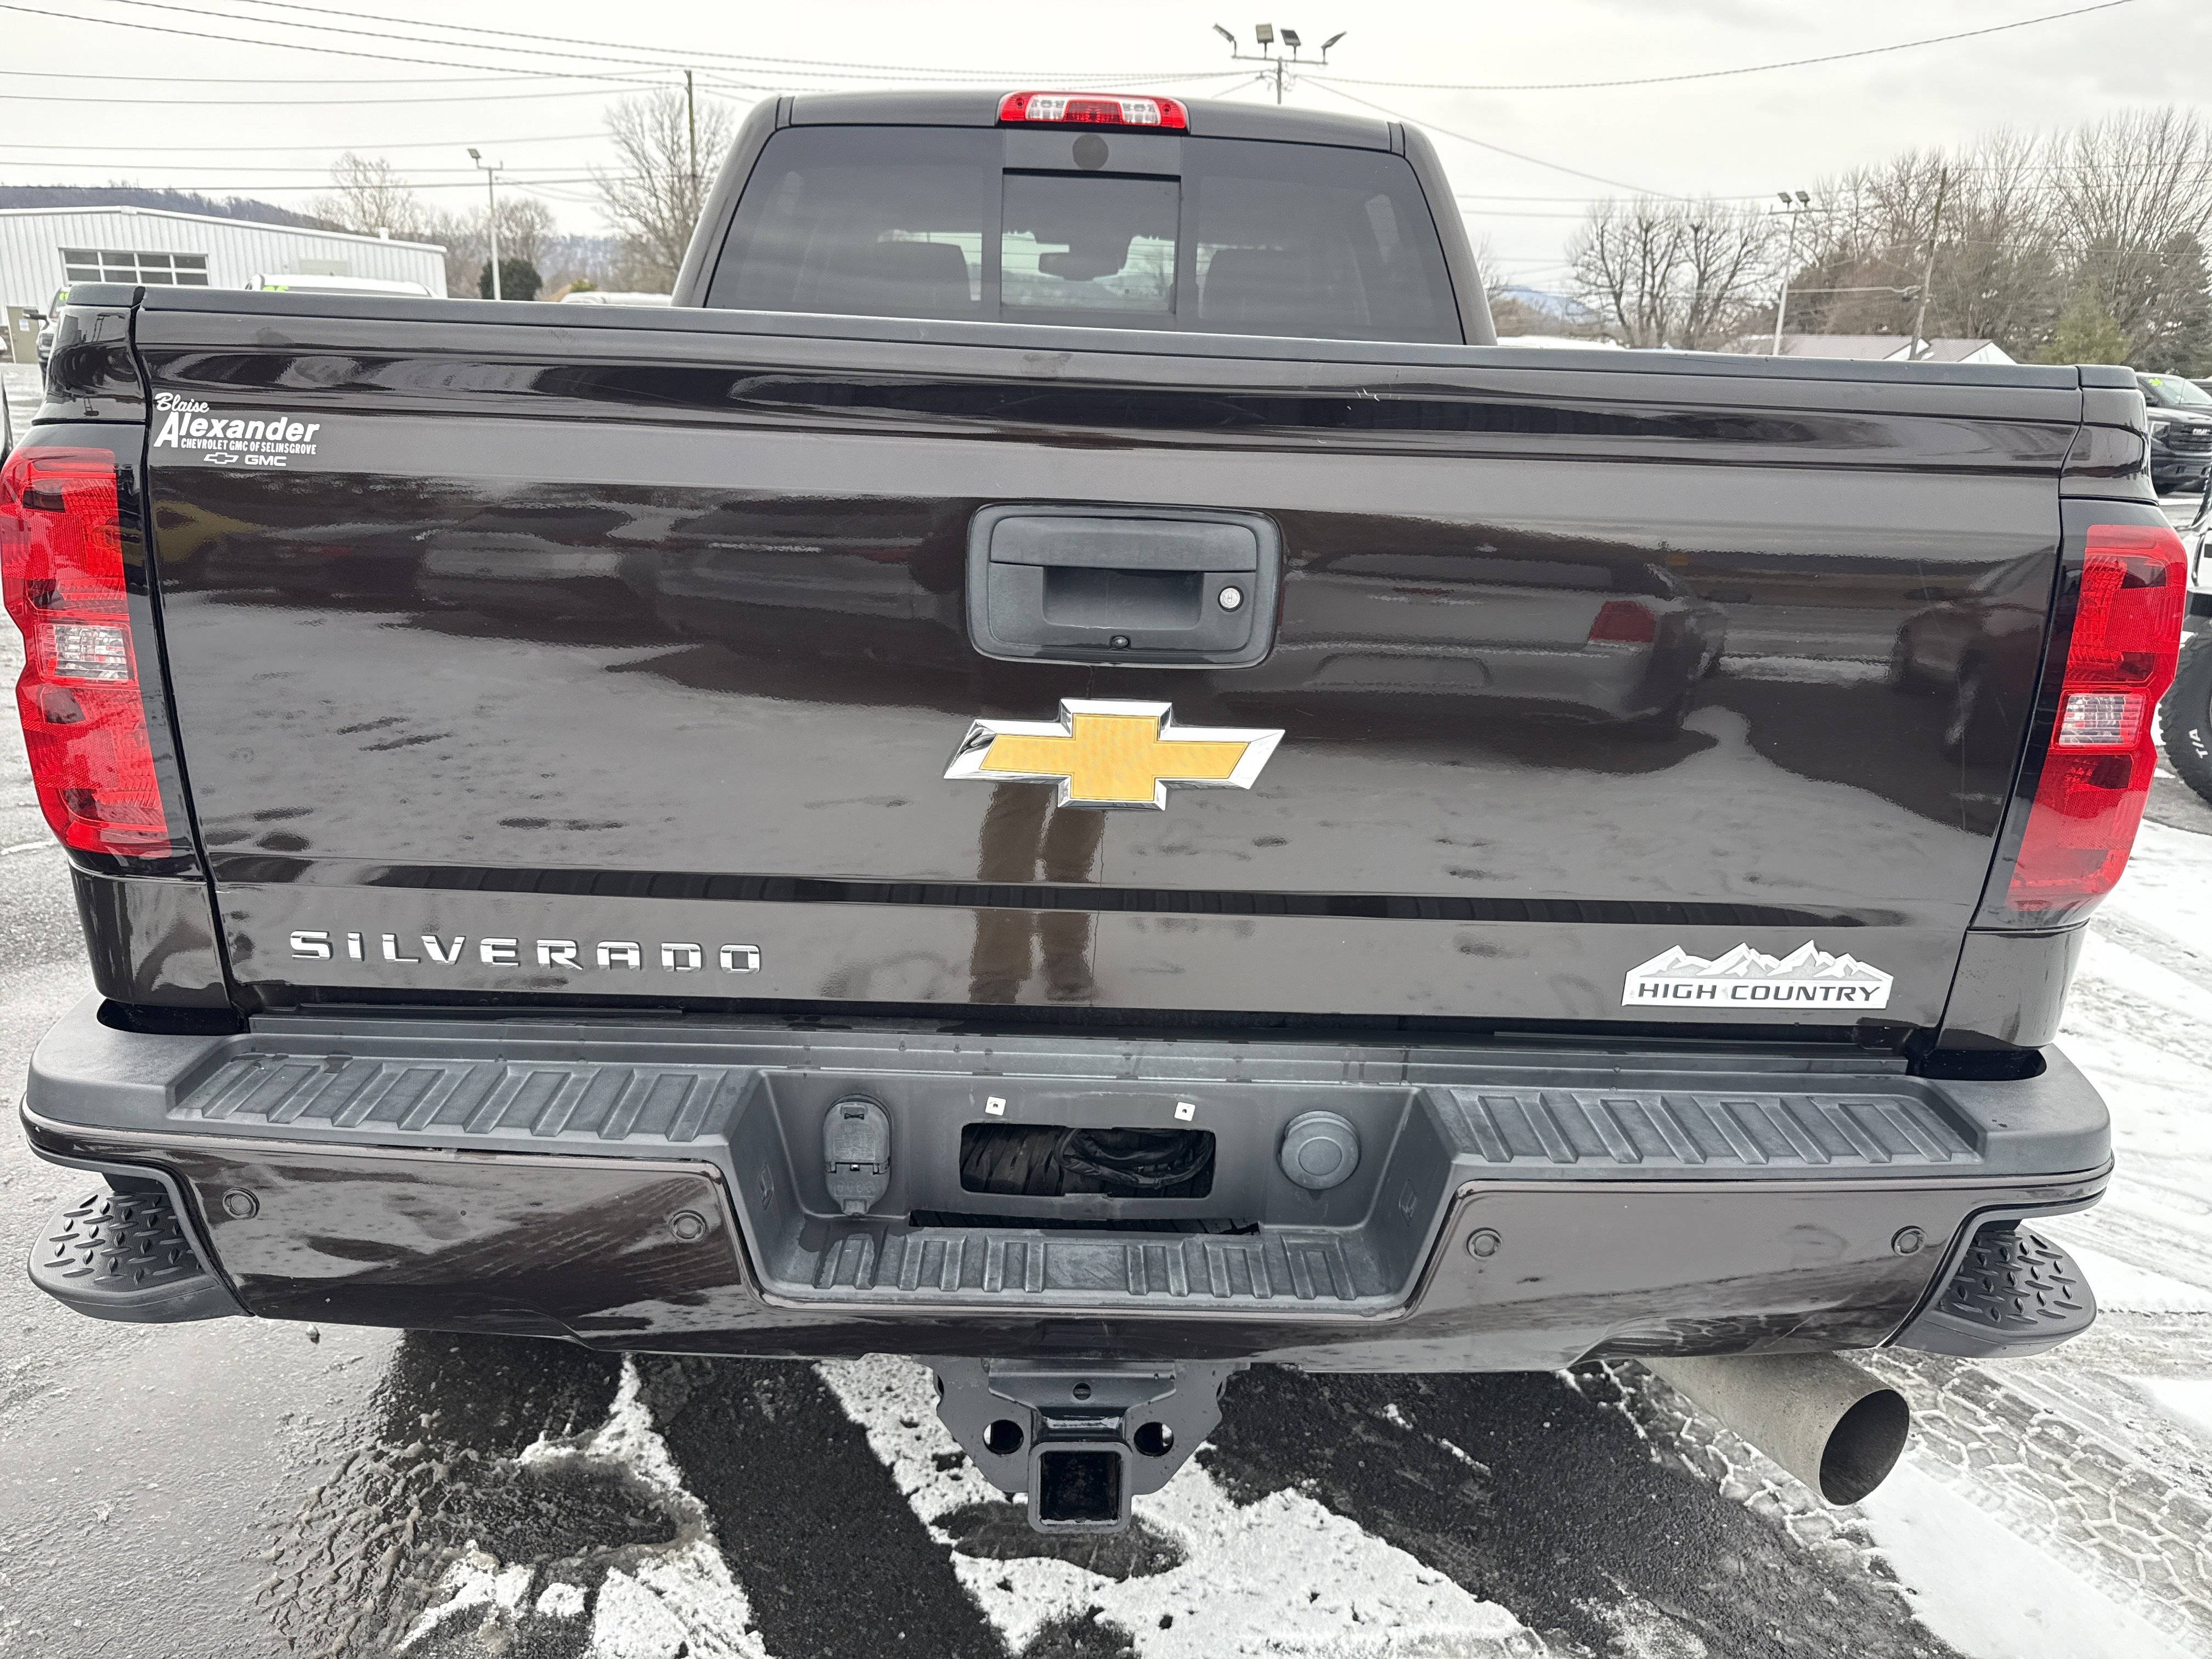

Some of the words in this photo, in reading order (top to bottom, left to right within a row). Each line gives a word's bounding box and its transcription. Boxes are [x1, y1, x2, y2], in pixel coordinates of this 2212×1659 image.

[155, 392, 210, 412] Blaise
[154, 411, 320, 448] Alexander
[181, 438, 228, 450] CHEVROLET
[229, 440, 248, 452] GMC
[250, 441, 259, 452] OF
[261, 442, 317, 455] SELINSGROVE
[245, 454, 287, 466] GMC
[2188, 728, 2208, 759] T/A
[290, 930, 761, 974] SILVERADO
[1638, 983, 1717, 999] HIGH
[1731, 985, 1881, 1002] COUNTRY
